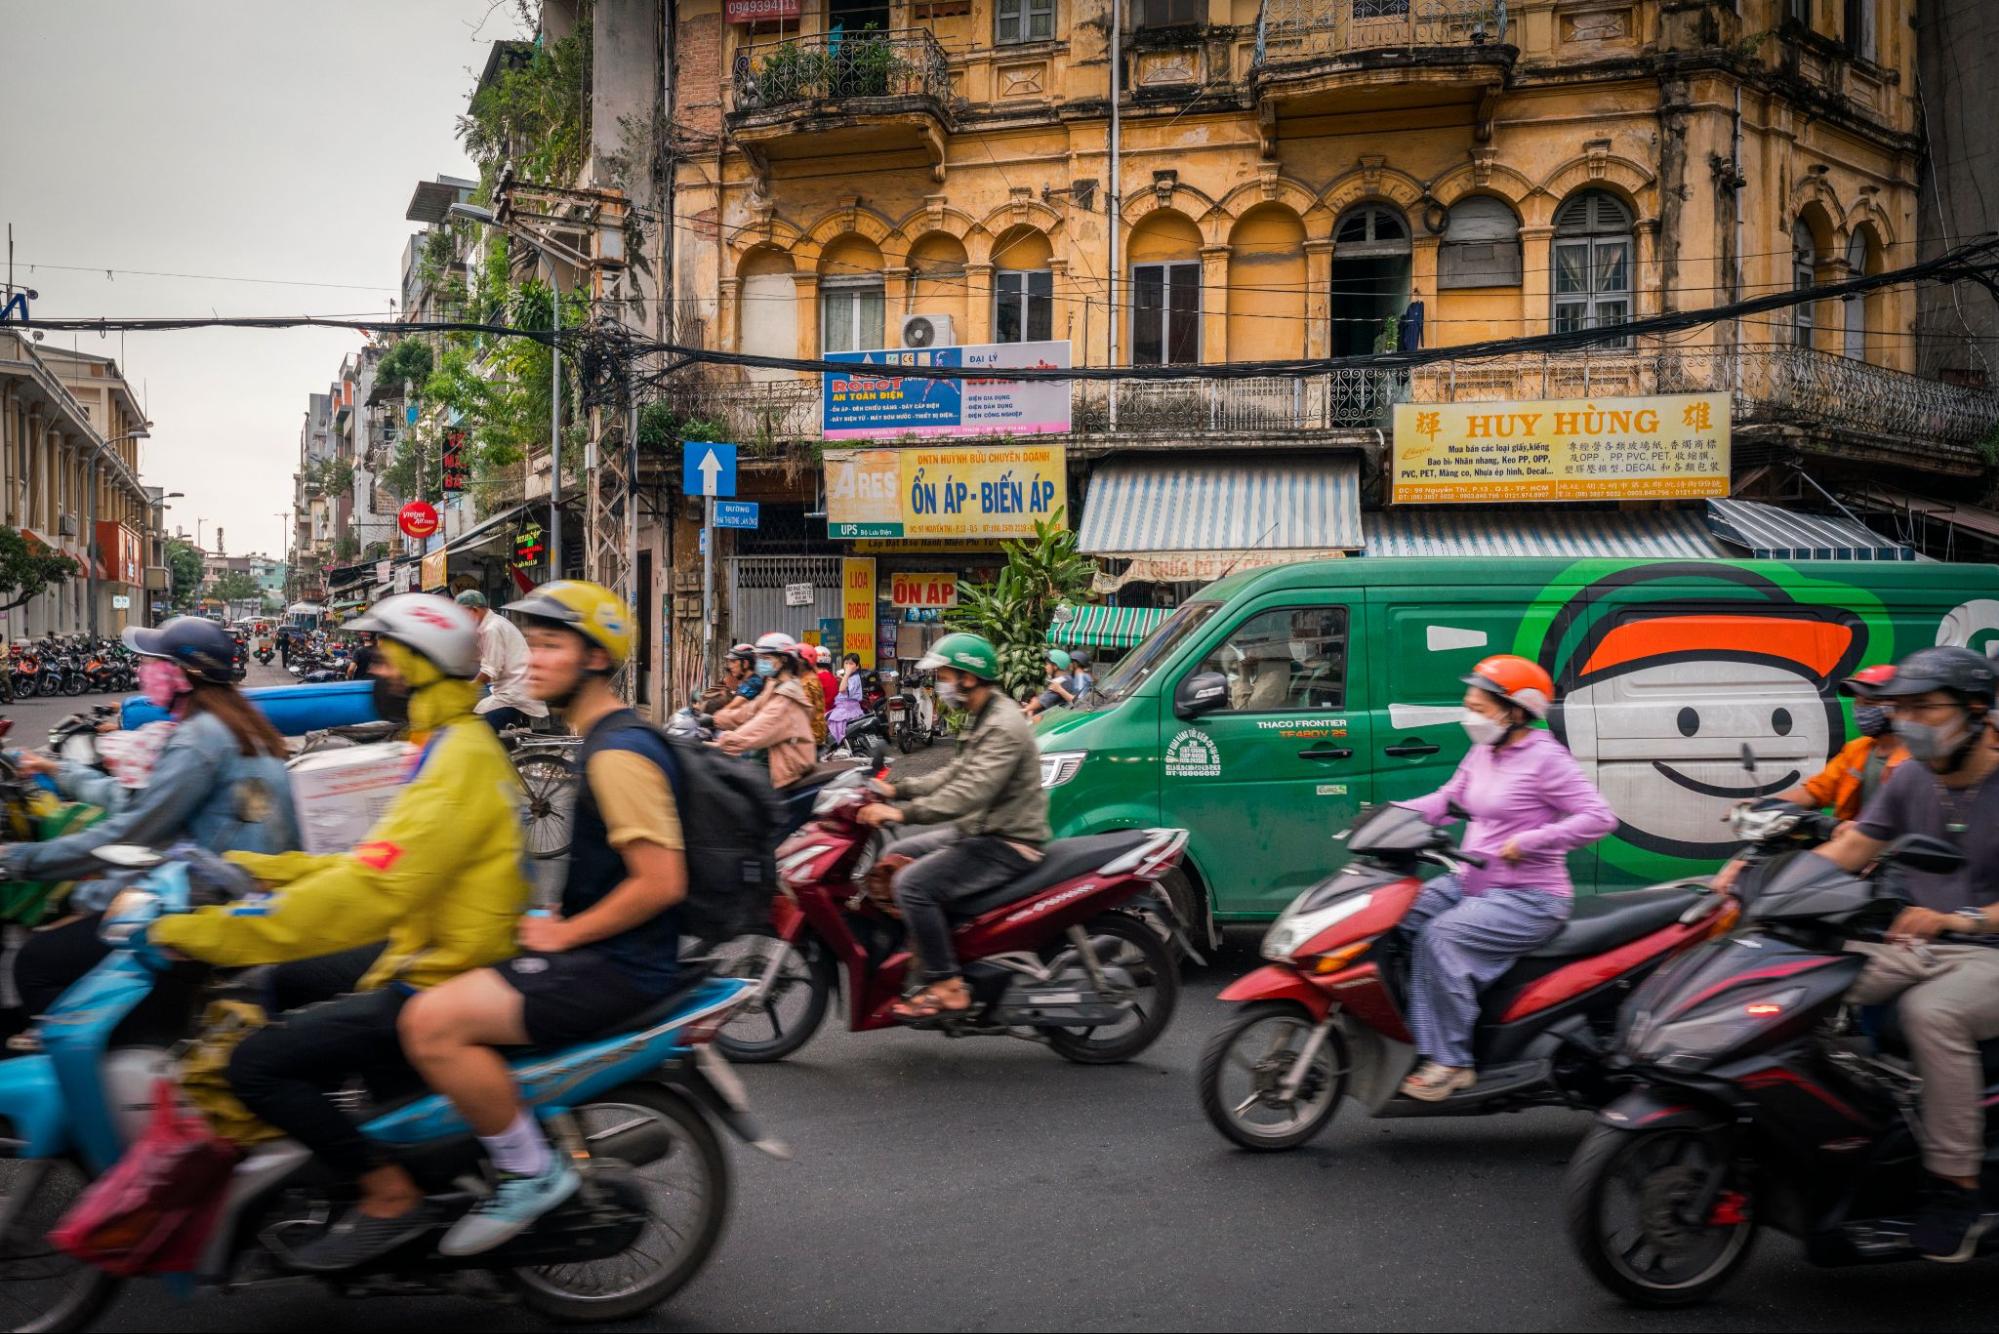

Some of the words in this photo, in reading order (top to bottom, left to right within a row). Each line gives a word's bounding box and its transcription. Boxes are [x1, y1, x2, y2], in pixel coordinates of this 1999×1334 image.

[729, 0, 797, 14] 094939411
[970, 355, 984, 364] ĐẠI
[989, 352, 998, 362] LÝ
[832, 379, 903, 393] ROBOT
[832, 393, 846, 402] AN
[850, 391, 877, 401] TOÀN
[880, 390, 904, 400] ĐIỆN
[1466, 413, 1543, 438] HUY
[1553, 403, 1660, 436] HÙNG
[1682, 401, 1713, 434] 雄
[1448, 445, 1464, 454] Mua
[1465, 444, 1480, 453] bán
[1481, 443, 1494, 453] các
[1496, 442, 1510, 453] loại
[1427, 457, 1442, 466] Bao
[1502, 455, 1516, 464] Keo
[1518, 455, 1531, 464] PP,
[1533, 454, 1551, 464] OPP,
[1401, 470, 1418, 479] PVC,
[1420, 469, 1437, 479] PET,
[1626, 463, 1657, 472] DECAL
[911, 467, 937, 514] ỔN
[944, 474, 968, 514] ÁP
[980, 469, 1024, 514] BIẾN
[1029, 473, 1055, 513] ÁP
[841, 524, 858, 536] UPS
[850, 571, 868, 589] LIOA
[893, 575, 922, 604] ỔN
[926, 577, 955, 604] ÁP
[848, 603, 870, 619] ROBOT
[1257, 720, 1294, 729] THACO
[1295, 719, 1347, 728] FRONTIER
